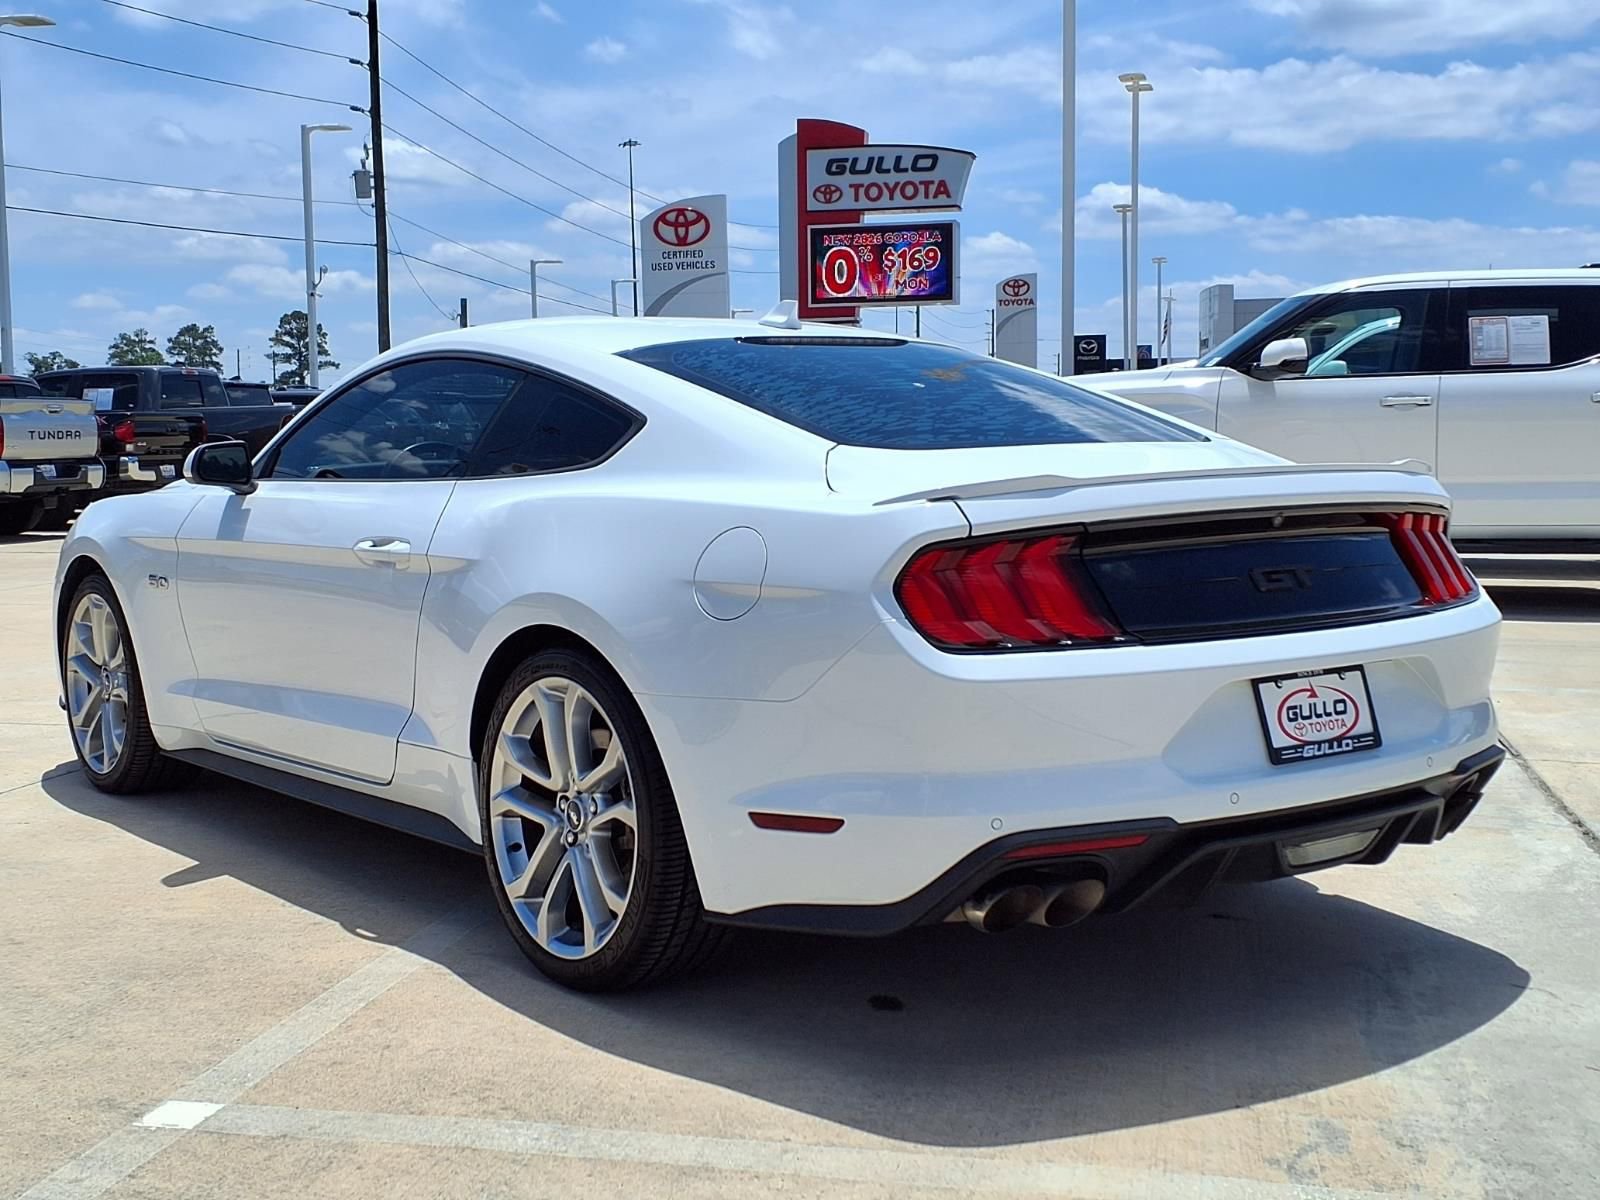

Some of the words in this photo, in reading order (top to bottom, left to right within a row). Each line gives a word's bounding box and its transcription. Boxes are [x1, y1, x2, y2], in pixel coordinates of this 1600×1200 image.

[826, 154, 939, 176] GULLO
[848, 179, 952, 203] TOYOTA
[823, 235, 852, 246] NEW
[661, 249, 704, 260] CERTIFIED
[882, 245, 941, 273] $169
[651, 262, 673, 271] USED
[675, 260, 716, 271] VEHICLES
[998, 298, 1035, 307] TOYOTA
[28, 430, 82, 440] TUNDRA
[1249, 566, 1312, 592] GT
[1286, 698, 1348, 723] GULLO
[1308, 718, 1348, 734] TOYOTA
[1302, 739, 1354, 757] GULLO
